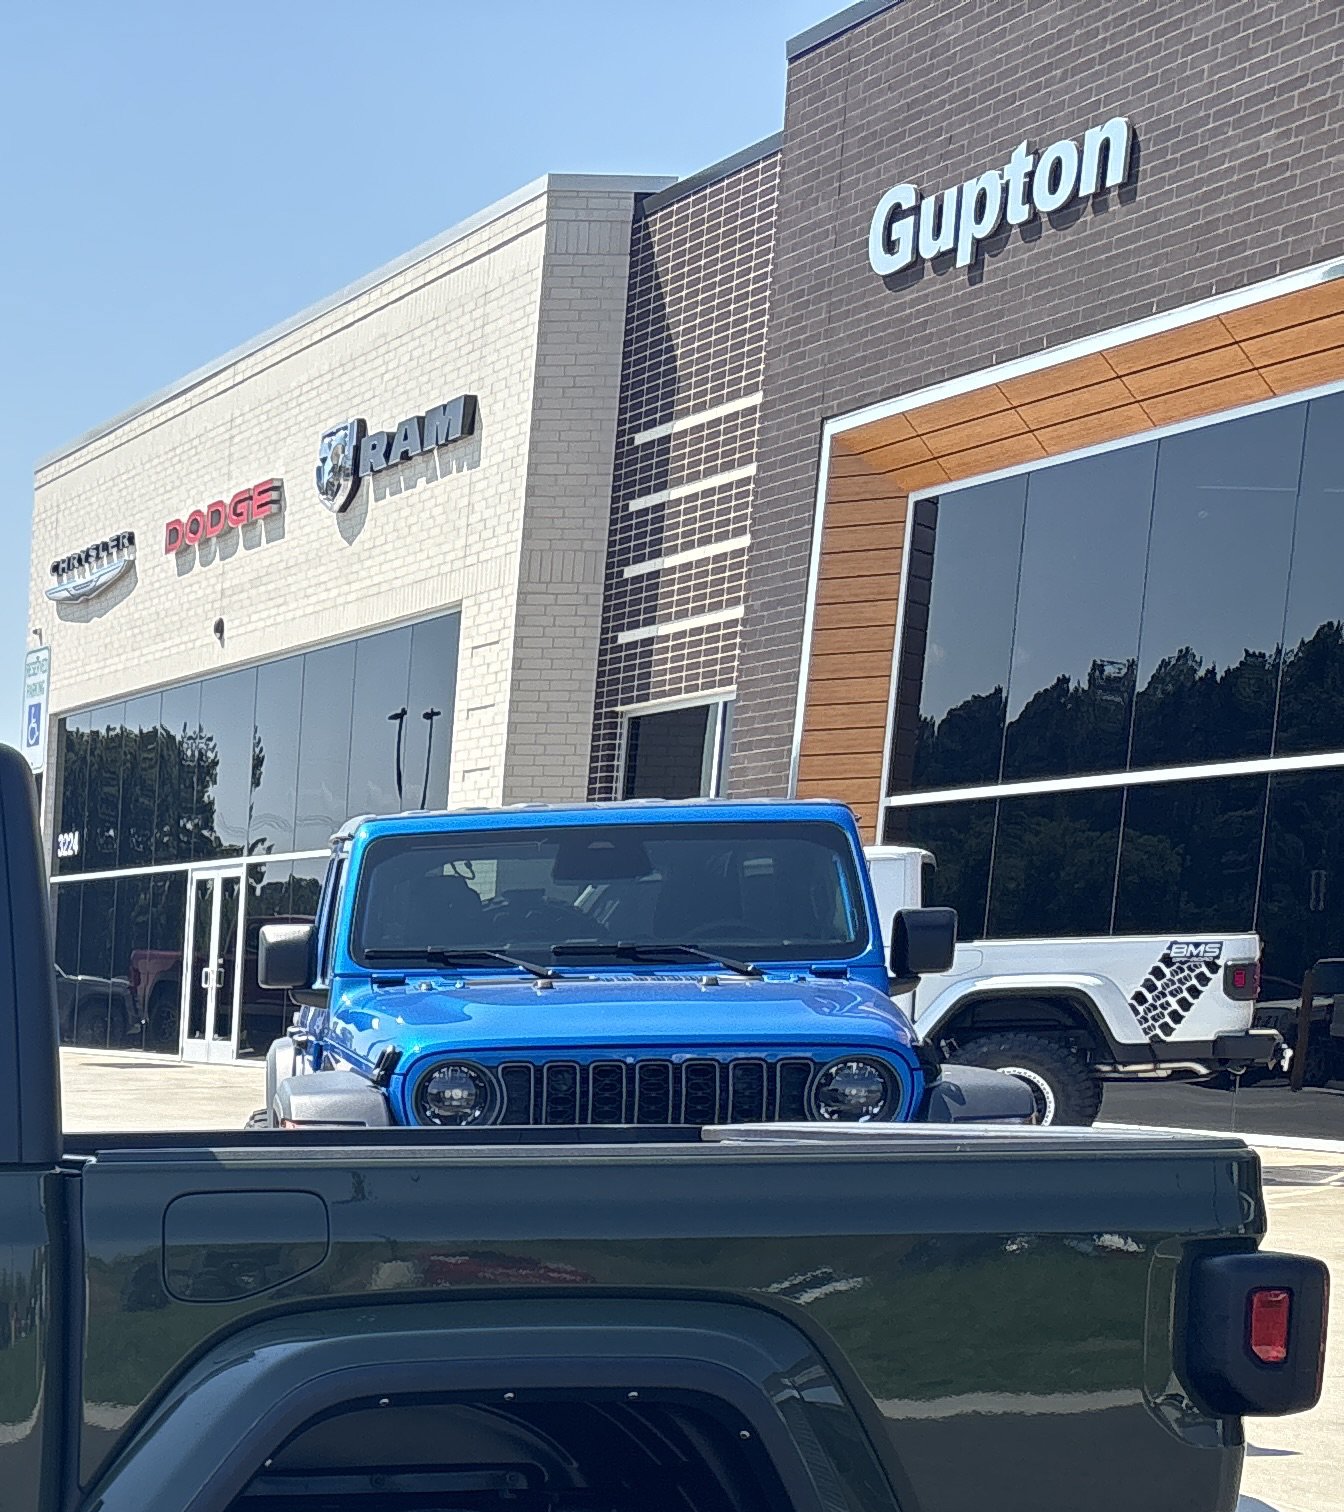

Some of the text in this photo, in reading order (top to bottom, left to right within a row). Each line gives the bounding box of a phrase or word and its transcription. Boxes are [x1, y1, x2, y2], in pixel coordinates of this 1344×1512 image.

[868, 116, 1132, 276] Gupton
[359, 394, 475, 477] RAM
[165, 478, 280, 554] DODGE
[50, 531, 135, 577] CHRYSLER
[57, 830, 80, 858] 3224
[1170, 943, 1221, 957] BMS
